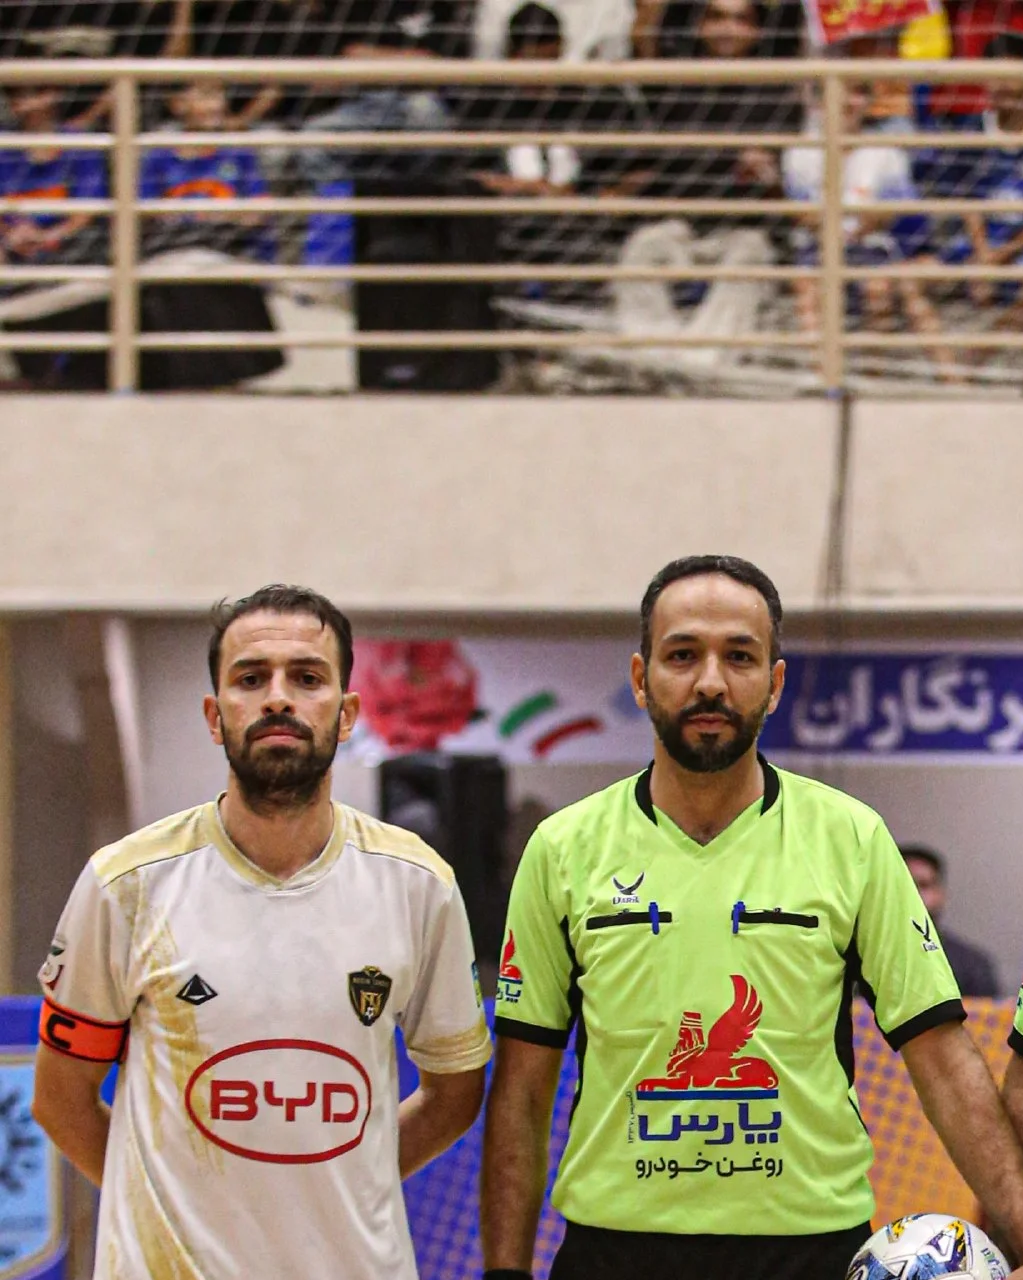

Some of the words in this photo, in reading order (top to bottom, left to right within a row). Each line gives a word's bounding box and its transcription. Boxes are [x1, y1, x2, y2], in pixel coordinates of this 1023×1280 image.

[46, 1013, 76, 1050] C
[210, 1079, 359, 1123] BYD
[637, 1102, 782, 1145] پارس
[635, 1152, 713, 1179] خودرو
[716, 1151, 783, 1178] روغن
